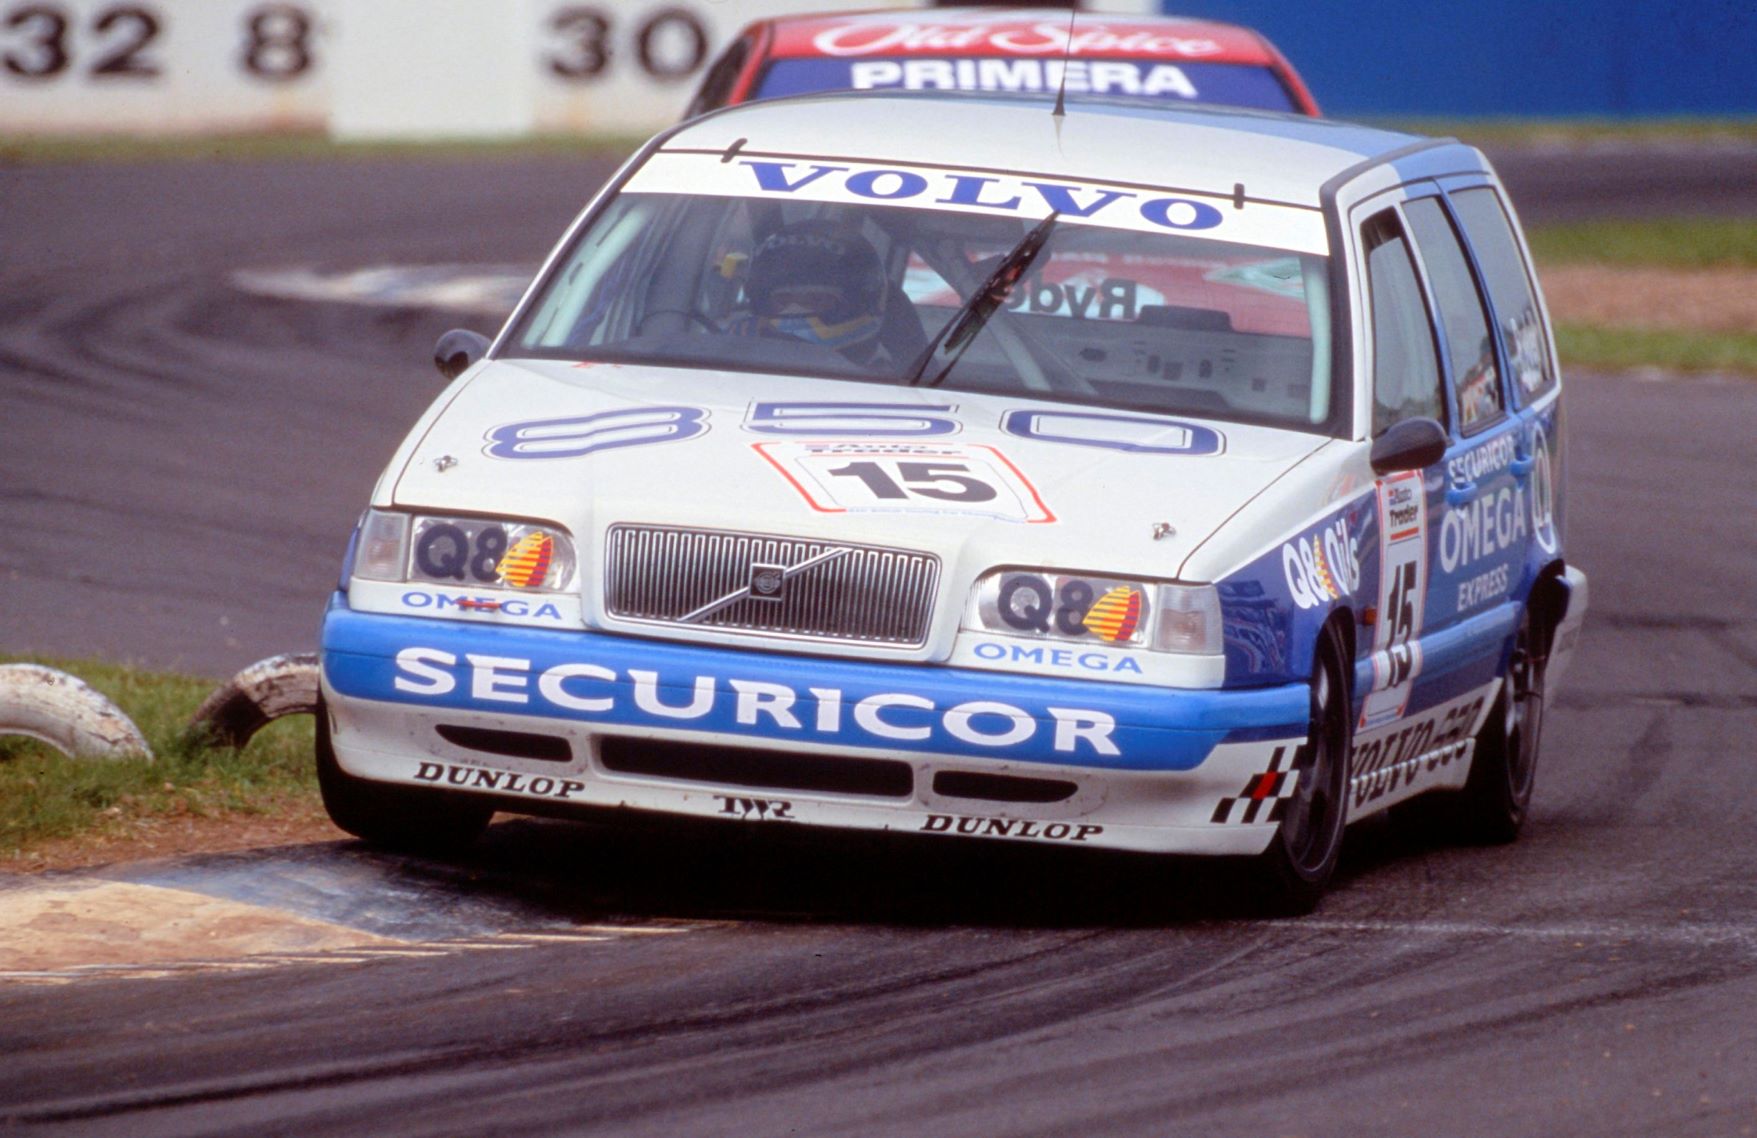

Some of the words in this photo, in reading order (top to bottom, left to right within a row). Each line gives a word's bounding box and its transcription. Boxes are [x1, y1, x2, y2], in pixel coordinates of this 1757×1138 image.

[2, 4, 162, 80] 32
[243, 4, 312, 80] 8
[546, 6, 708, 82] 30
[813, 22, 988, 57] Old
[990, 20, 1226, 55] Spice
[850, 59, 1198, 98] PRIMERA
[738, 161, 1223, 231] VOLVO
[482, 398, 1226, 457] 850
[827, 461, 998, 502] 15
[416, 523, 508, 582] Q8
[1440, 487, 1527, 574] OMEGA
[1283, 543, 1330, 609] Q8
[1325, 518, 1359, 596] Oils
[1457, 563, 1509, 612] EXPRESS
[401, 591, 562, 620] OMEGA
[997, 575, 1094, 636] Q8
[1386, 561, 1416, 687] 15
[973, 643, 1143, 674] OMEGA
[394, 647, 1121, 756] SECURICOR
[413, 761, 585, 798] DUNLOP
[712, 795, 795, 820] TWR
[920, 814, 1104, 841] DUNLOP
